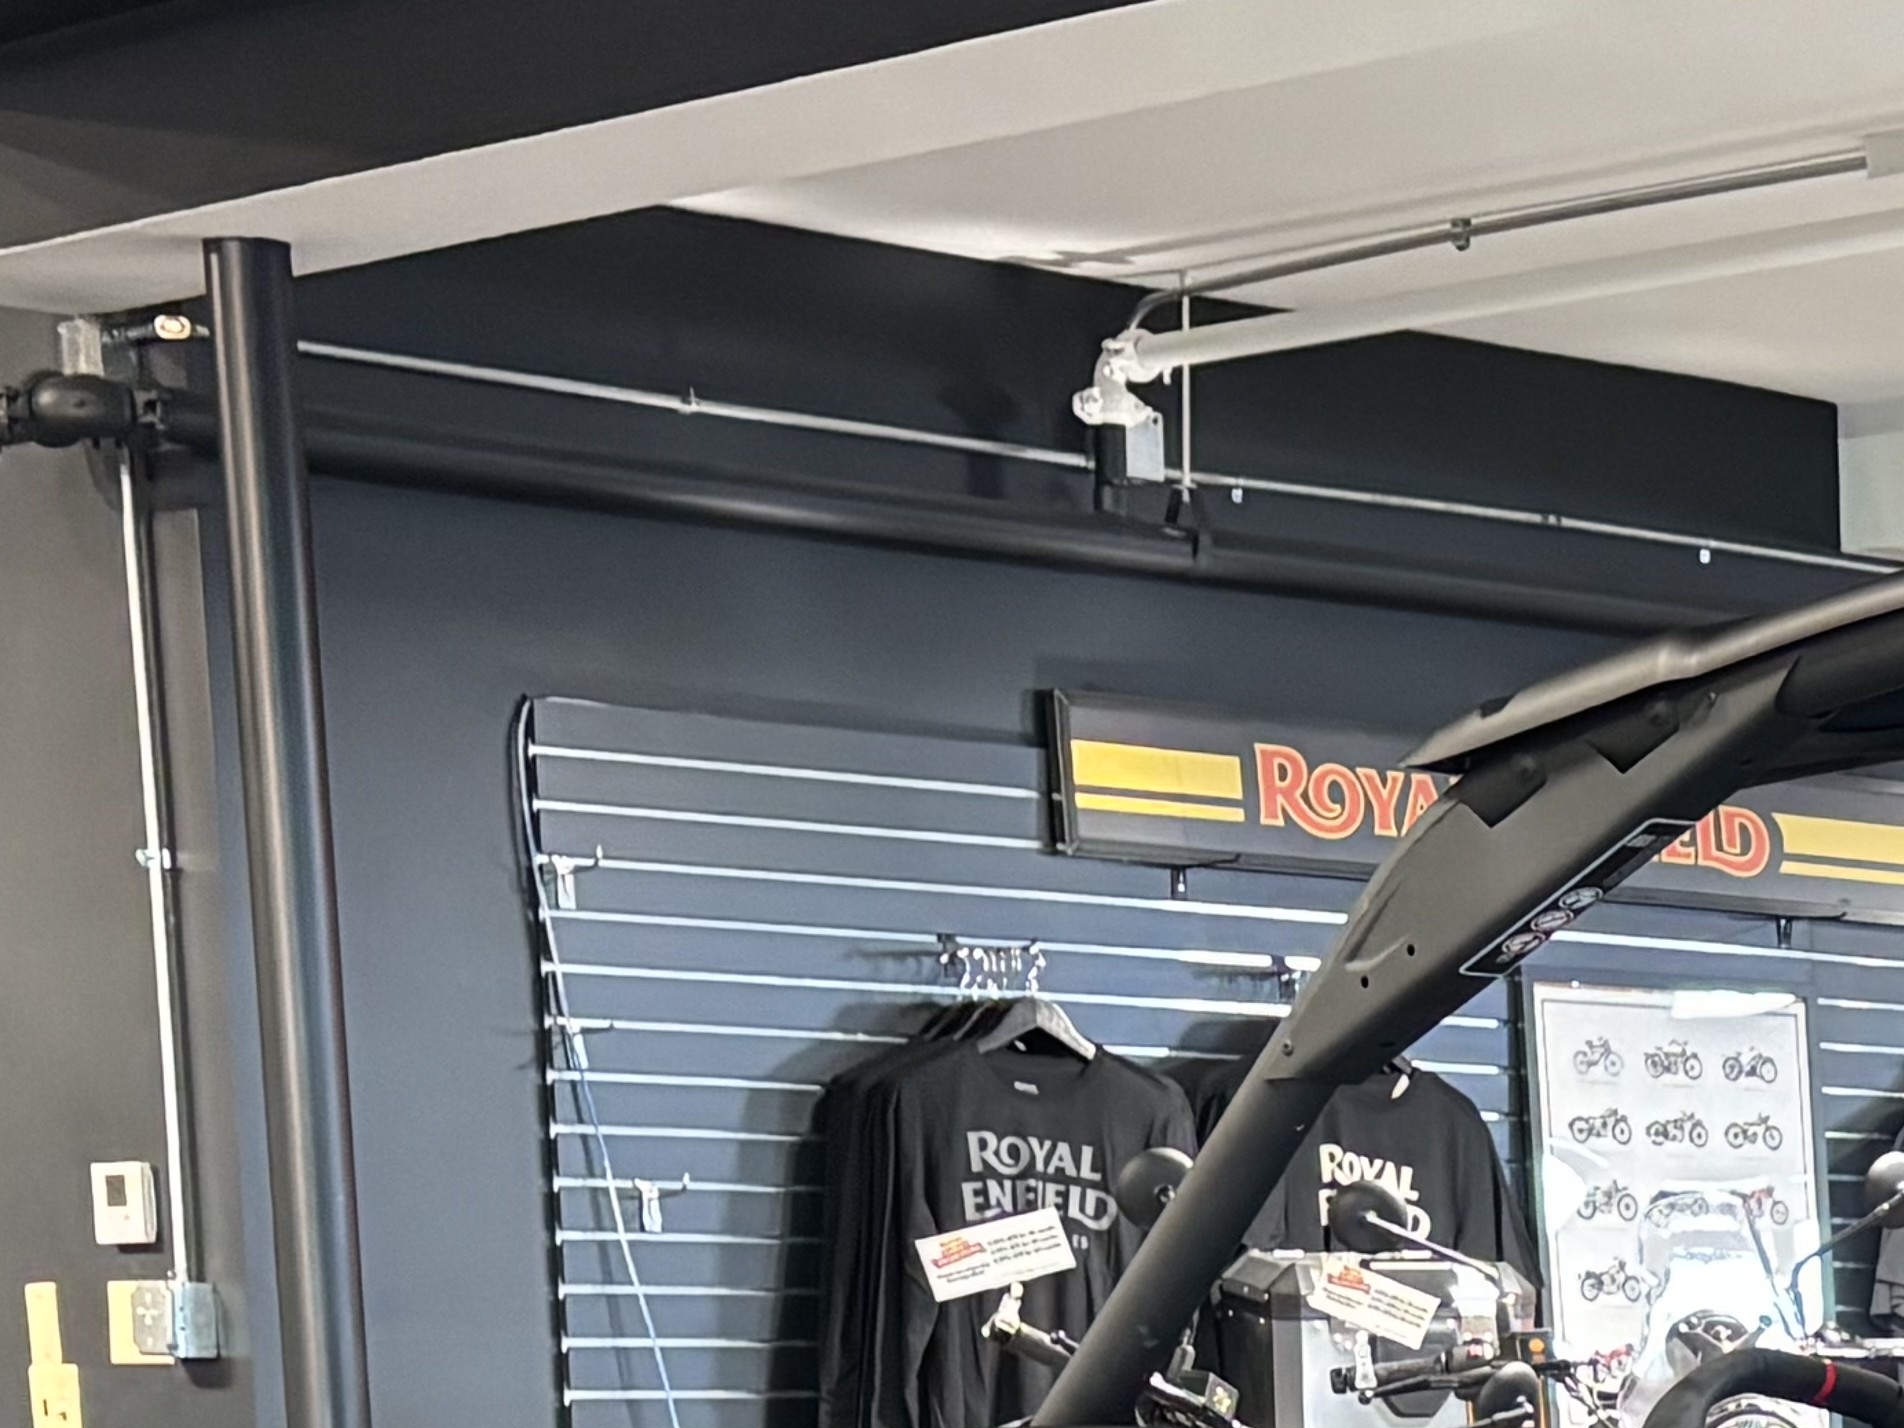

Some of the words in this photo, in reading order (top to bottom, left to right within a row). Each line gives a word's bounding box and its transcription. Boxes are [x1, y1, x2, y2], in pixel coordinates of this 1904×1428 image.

[1254, 743, 1463, 840] ROYA
[967, 1130, 1102, 1181] ROYAL
[1318, 1143, 1419, 1201] ROYAL
[961, 1178, 1118, 1231] ENFIELD
